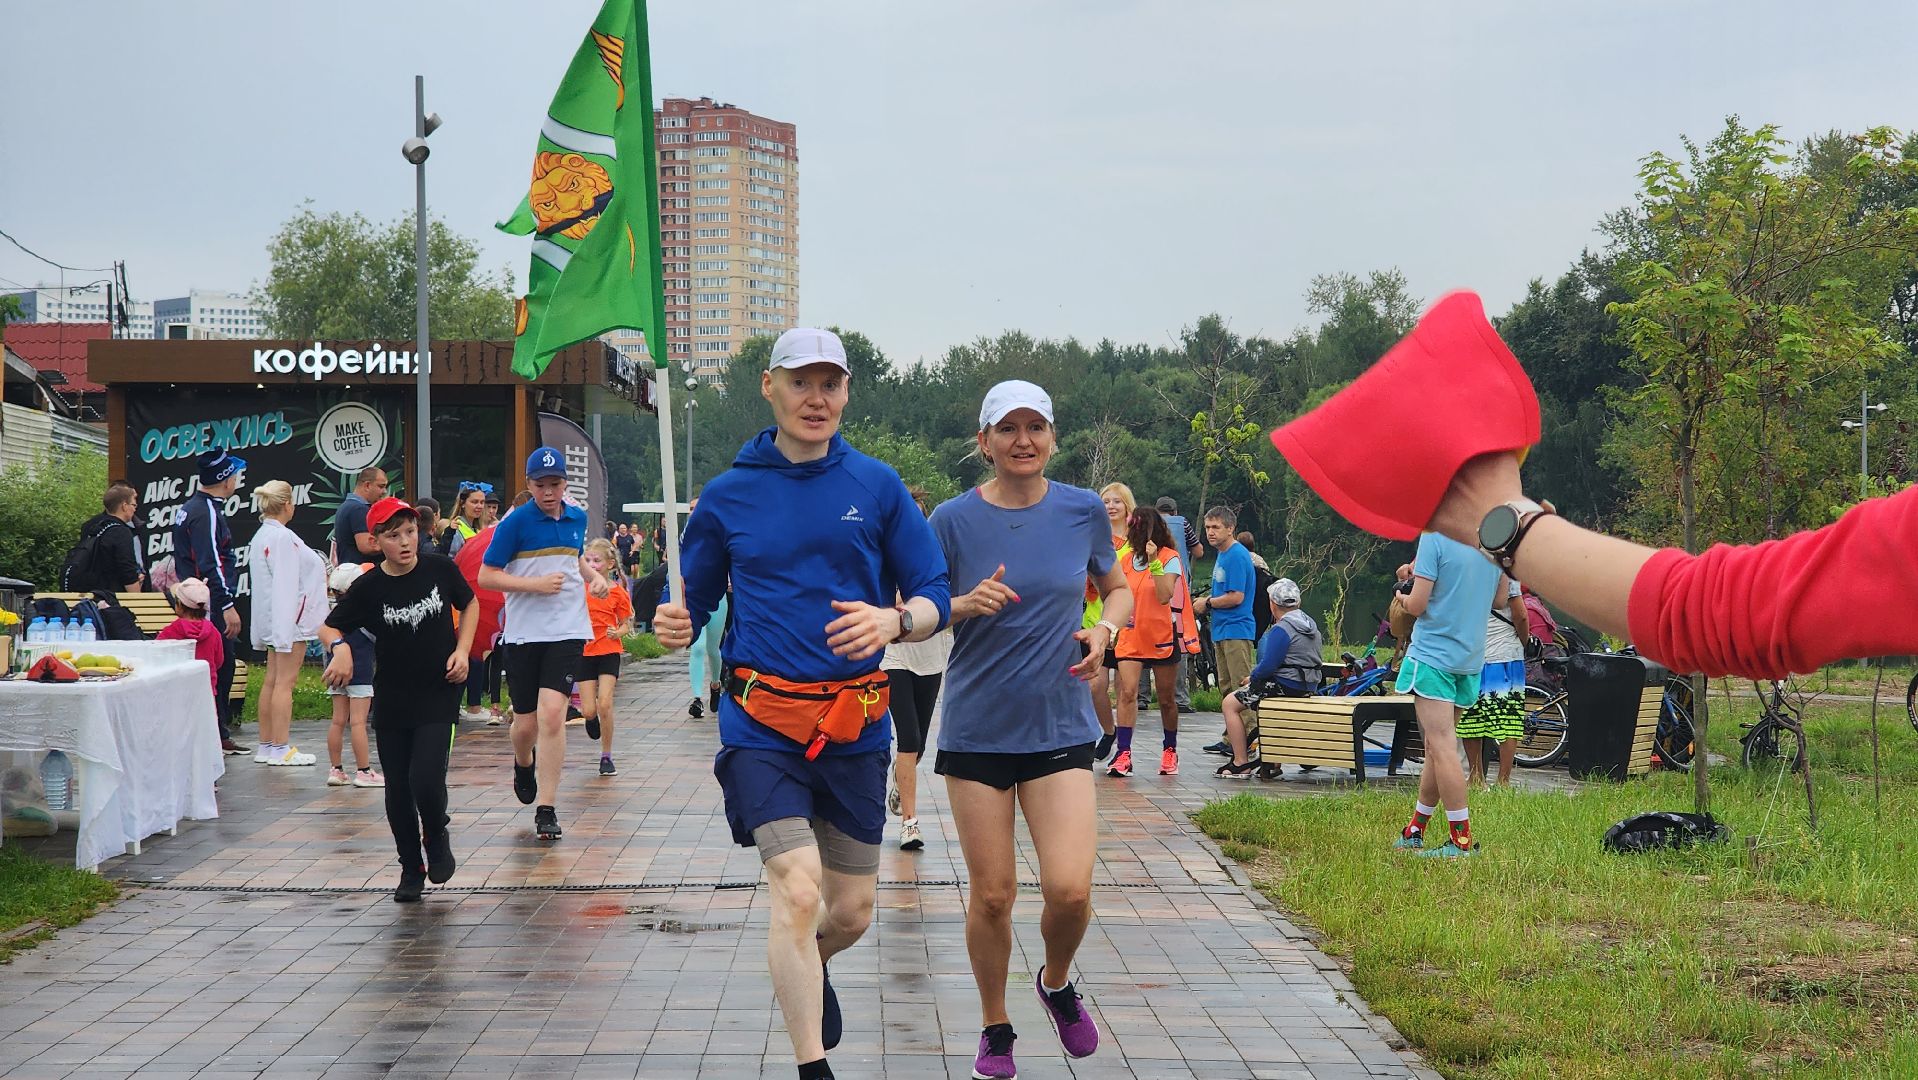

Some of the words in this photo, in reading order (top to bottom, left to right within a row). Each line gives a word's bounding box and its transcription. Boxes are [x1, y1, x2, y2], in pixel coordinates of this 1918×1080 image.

[140, 411, 293, 464] ОСВЕЖИСЬ
[335, 421, 366, 437] MAKE
[333, 433, 372, 452] COFFEE
[143, 476, 184, 504] АЙС
[841, 515, 864, 523] DEMIX
